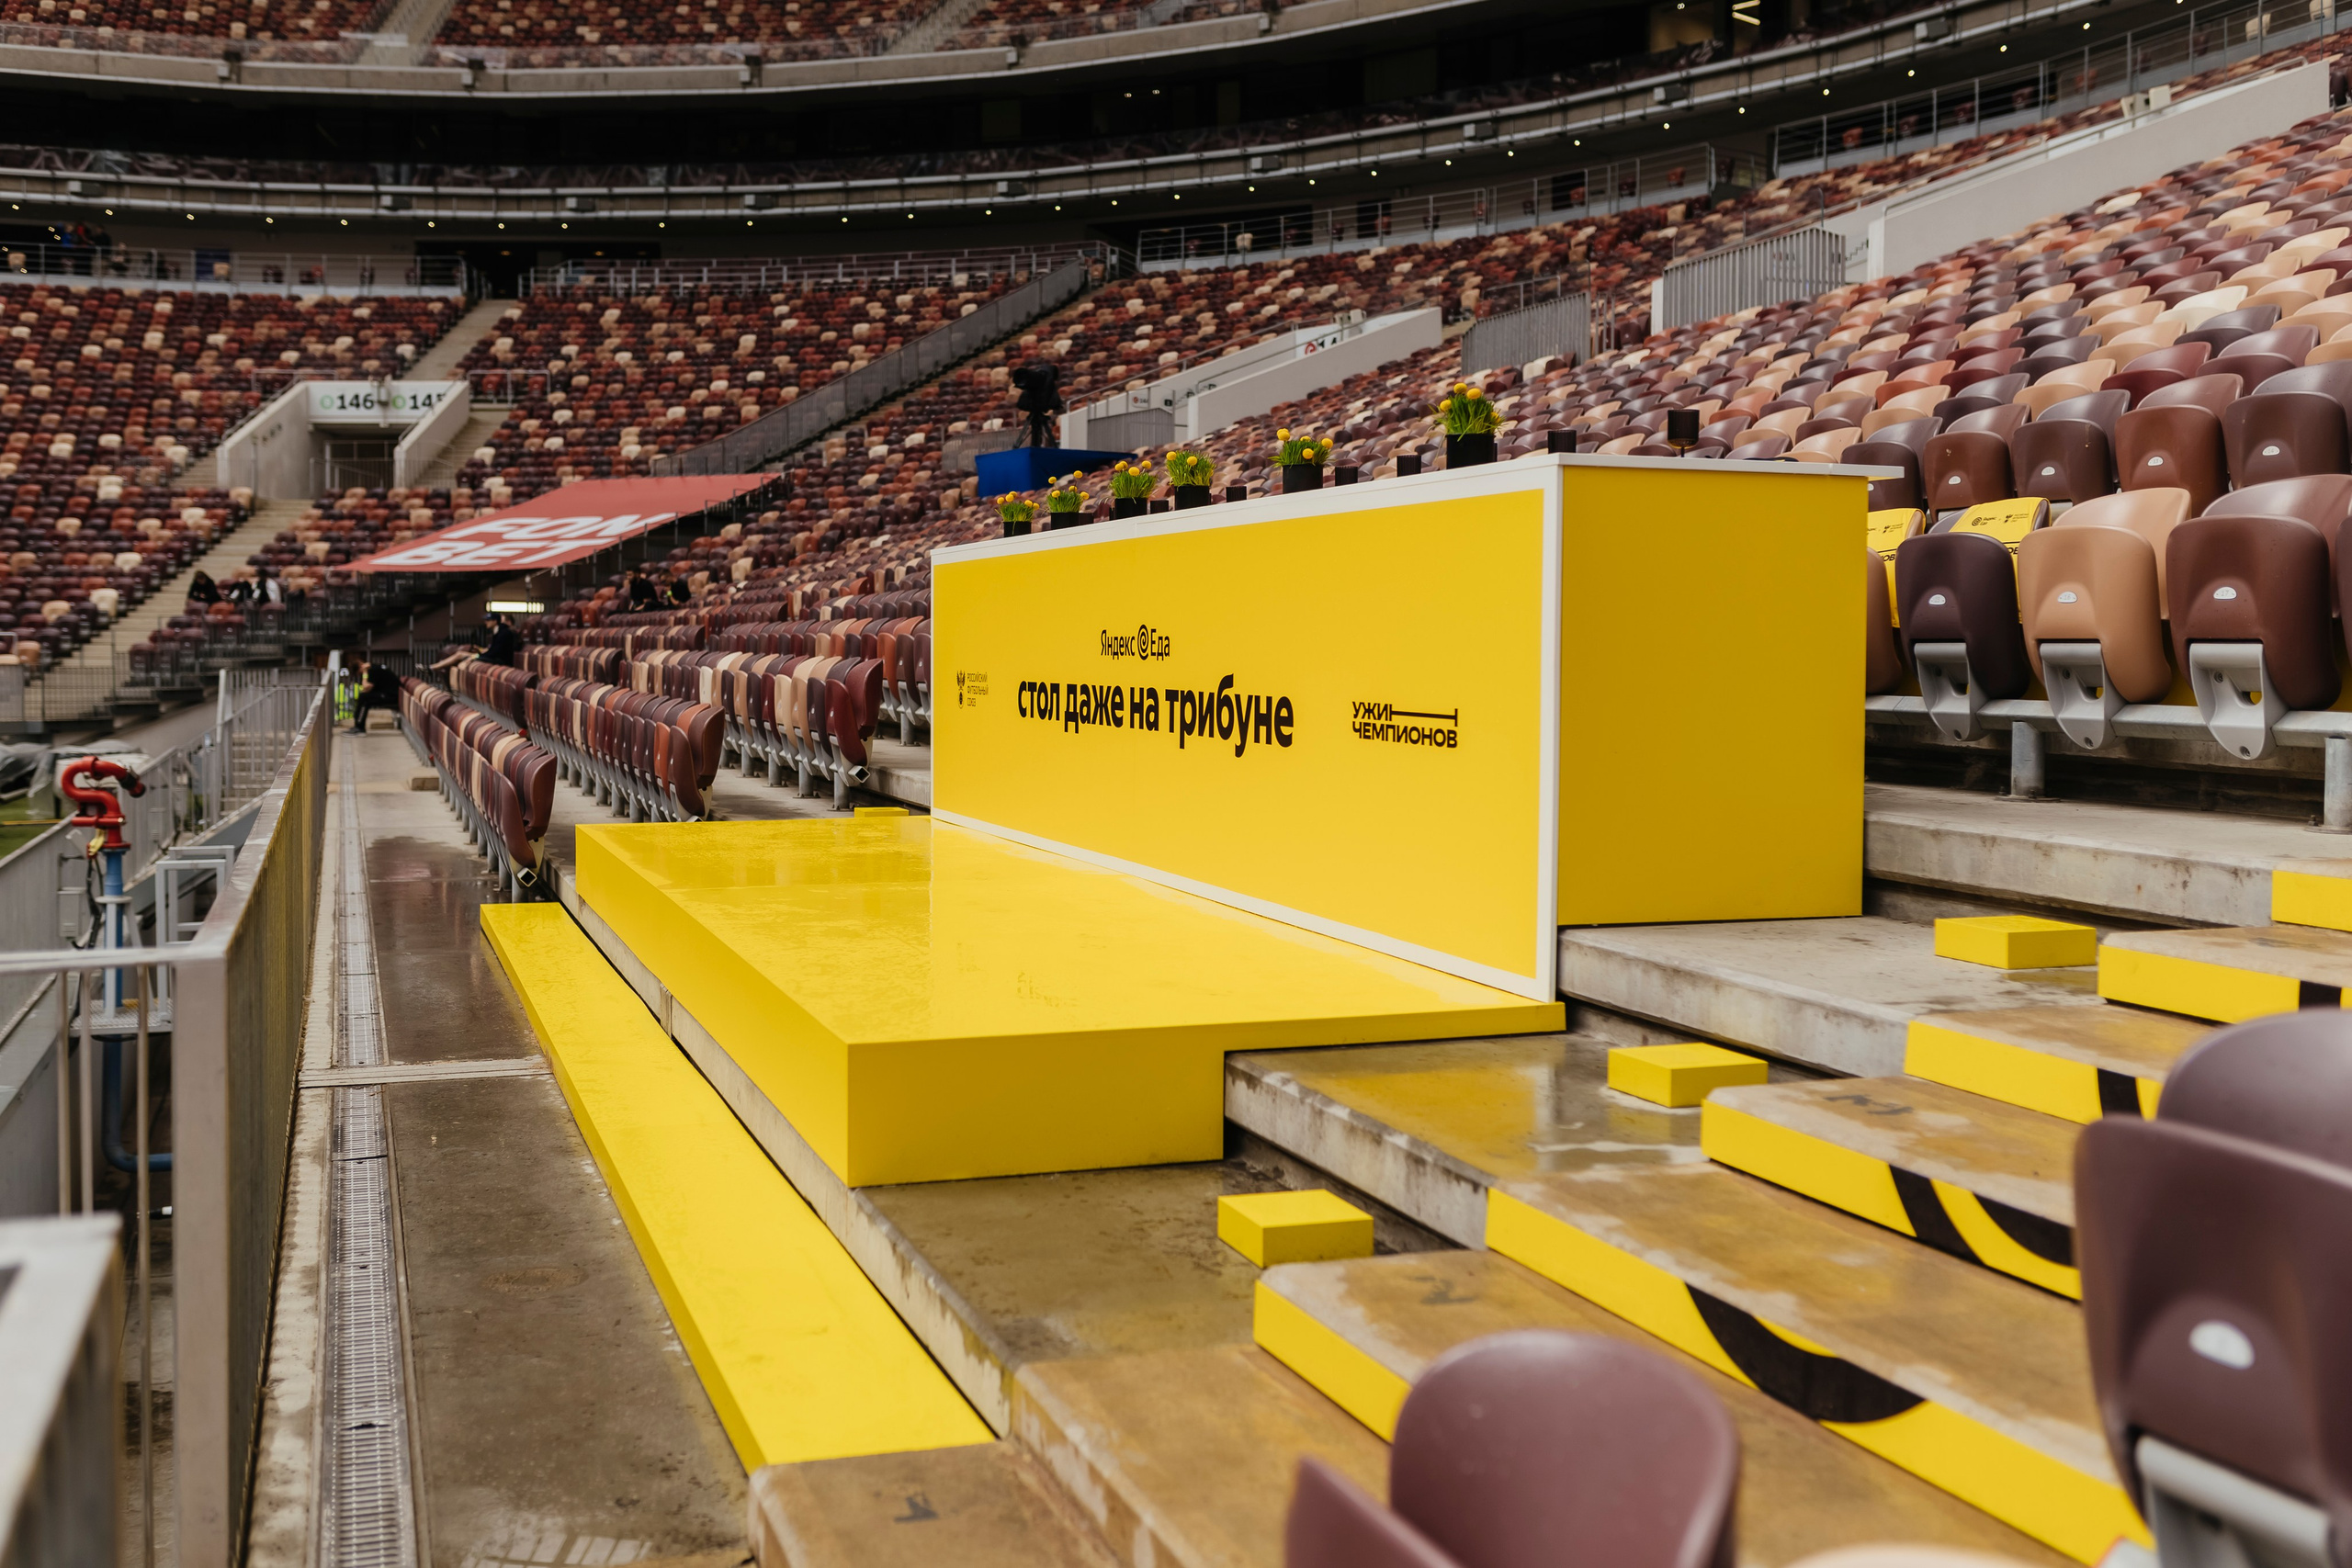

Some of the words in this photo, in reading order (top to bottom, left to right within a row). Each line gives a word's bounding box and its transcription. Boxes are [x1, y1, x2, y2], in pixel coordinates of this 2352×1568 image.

[336, 393, 375, 410] 146
[439, 512, 678, 540] FON
[368, 536, 617, 567] BET
[1101, 629, 1136, 660] Яндекс
[1150, 628, 1170, 661] Еда
[1018, 680, 1060, 721] стол
[1064, 682, 1125, 734] даже
[1129, 686, 1159, 731] на
[1165, 672, 1295, 758] трибуне
[1351, 720, 1458, 749] ЧЕМПИОНОВ
